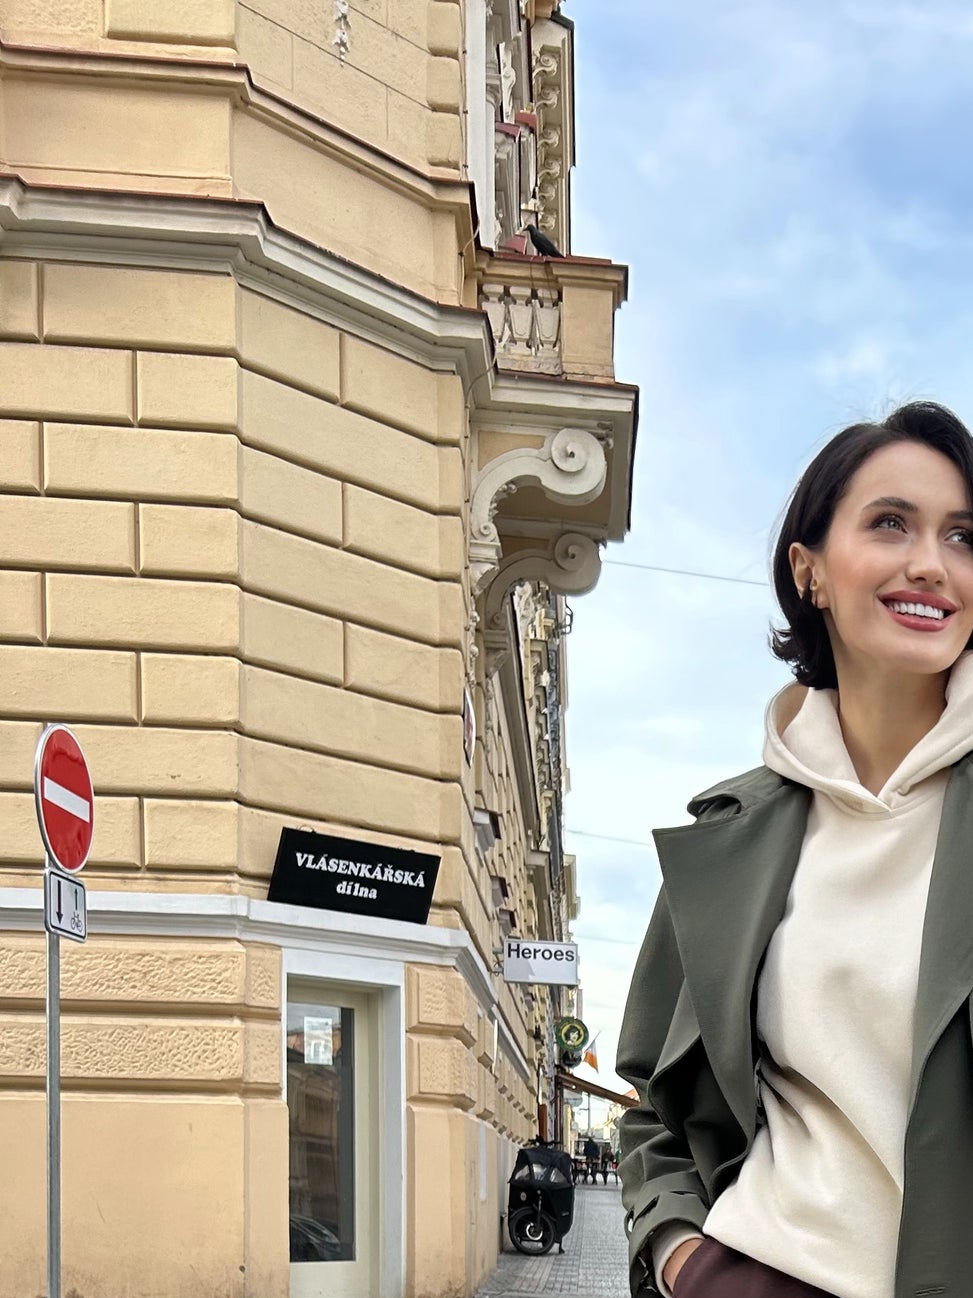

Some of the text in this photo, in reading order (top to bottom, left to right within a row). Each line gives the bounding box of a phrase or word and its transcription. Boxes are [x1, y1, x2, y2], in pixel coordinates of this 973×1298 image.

[296, 852, 425, 887] VLÁSENKÁŘSKÁ
[336, 881, 377, 899] dílna
[507, 943, 575, 962] Heroes
